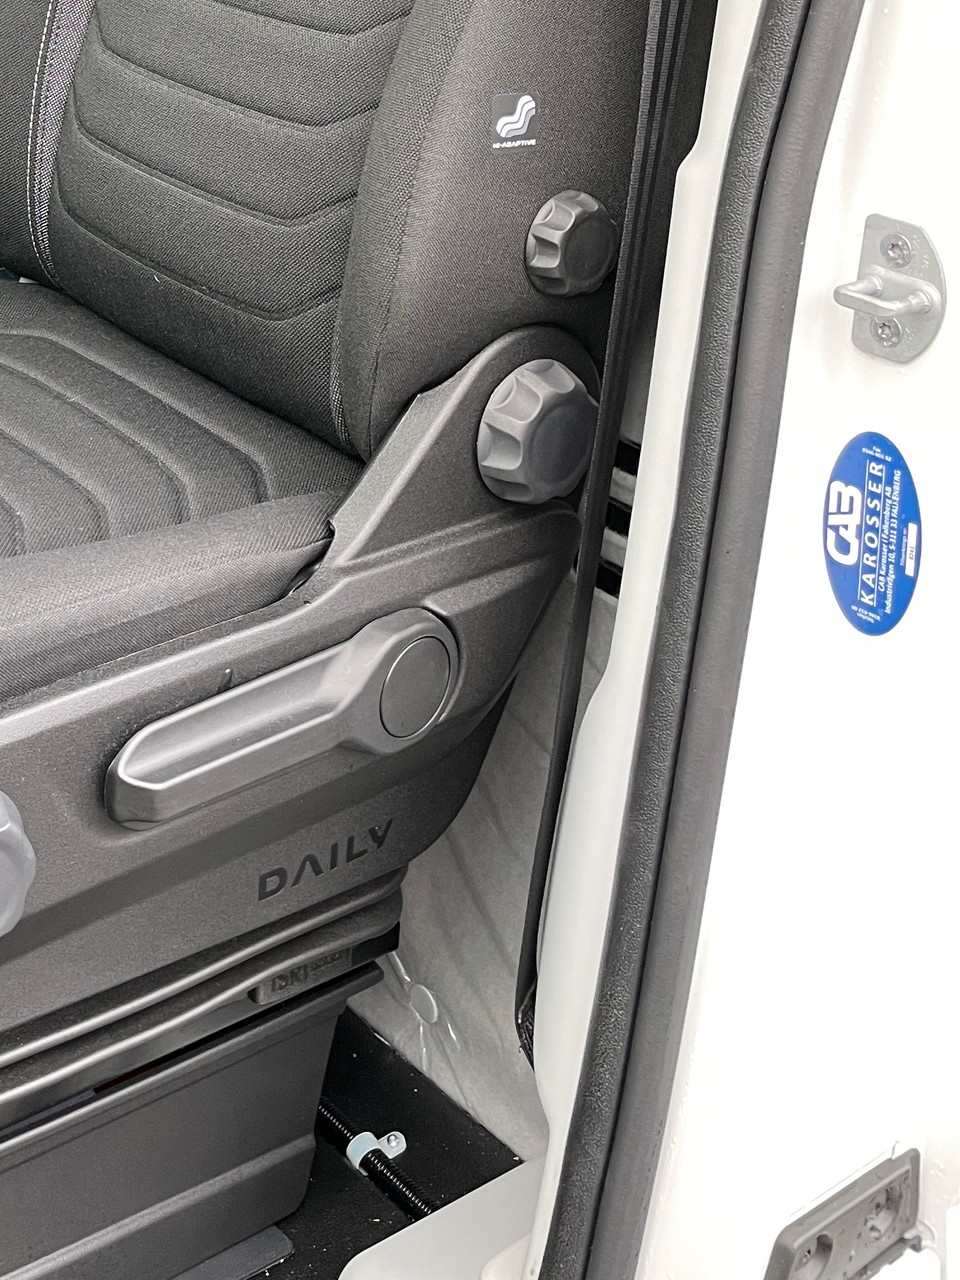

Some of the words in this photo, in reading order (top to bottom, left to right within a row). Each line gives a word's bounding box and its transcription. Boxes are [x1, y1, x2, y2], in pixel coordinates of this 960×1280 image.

[826, 480, 862, 566] CAB
[860, 461, 883, 606] KAROSSER
[881, 498, 892, 539] Falkenberg
[890, 519, 898, 529] 33
[879, 544, 888, 576] Karosser
[258, 819, 393, 902] DAILY
